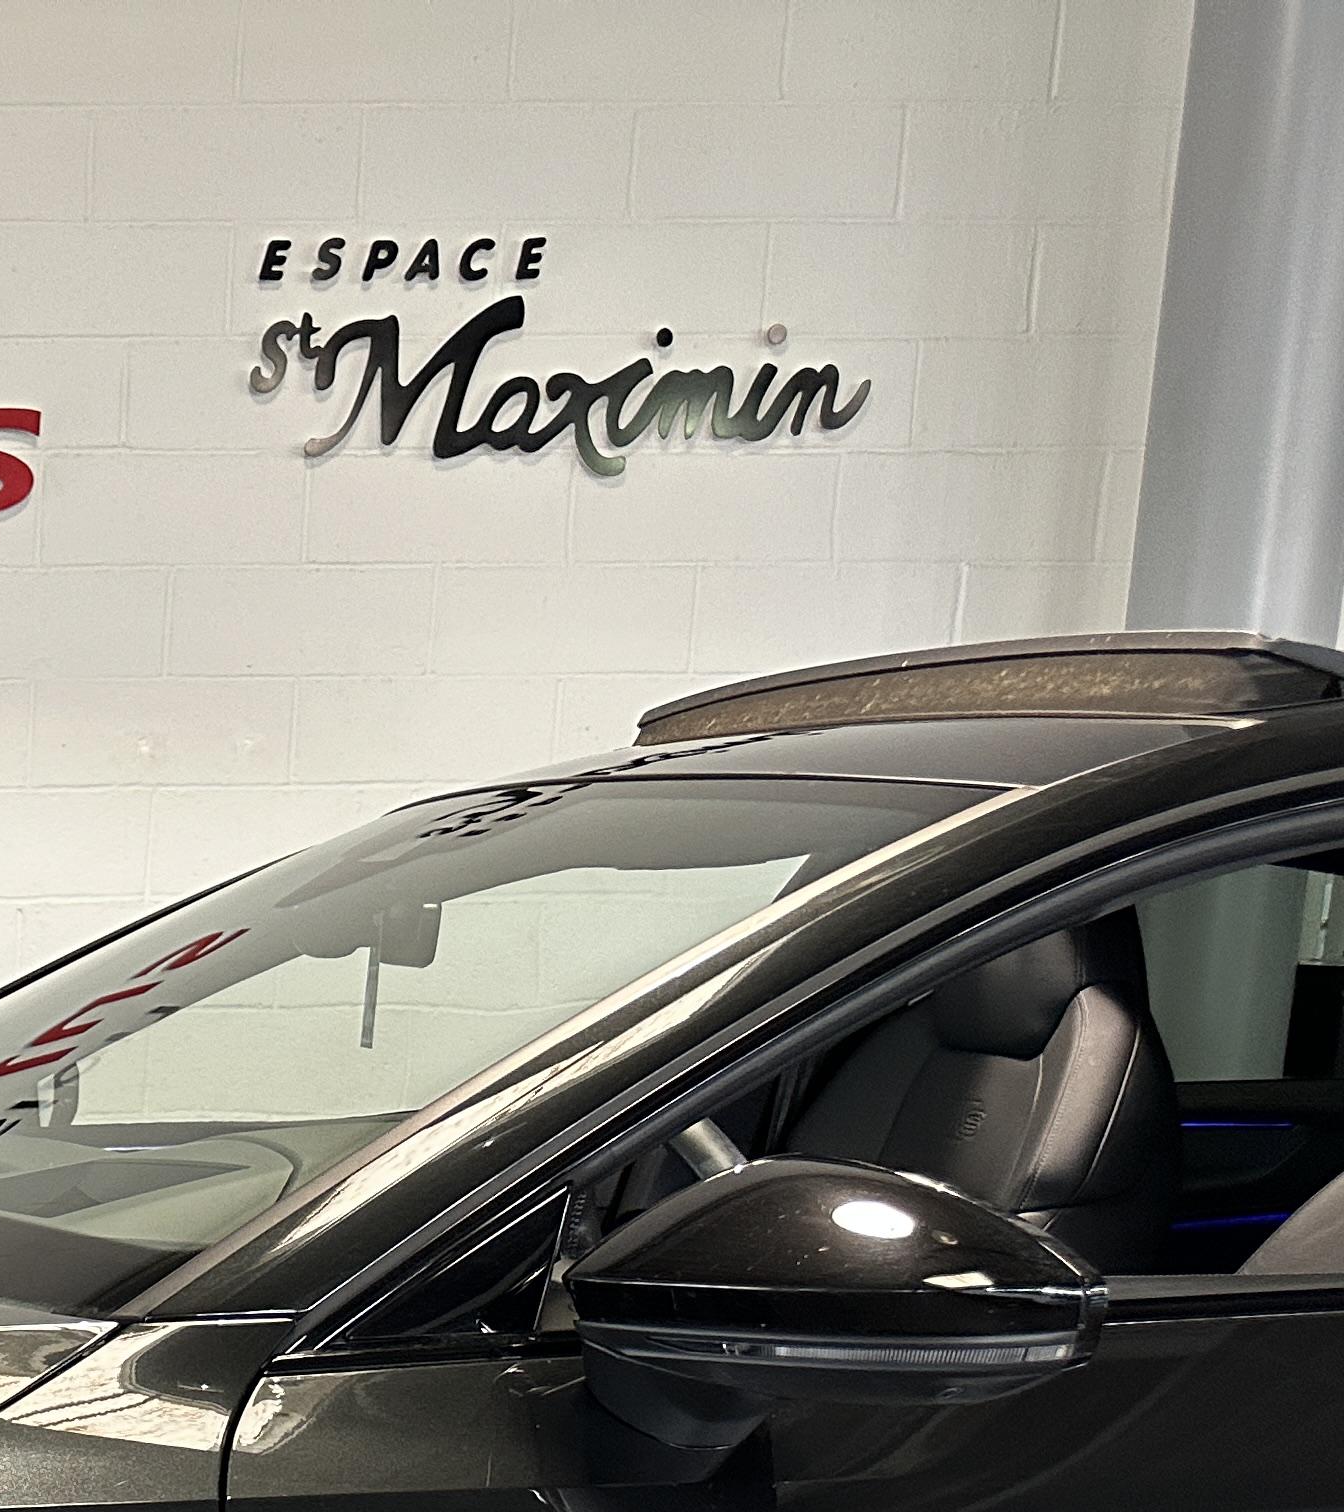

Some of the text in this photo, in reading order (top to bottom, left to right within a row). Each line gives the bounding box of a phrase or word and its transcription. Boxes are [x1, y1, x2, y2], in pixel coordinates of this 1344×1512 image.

[258, 237, 547, 282] ESPACE
[249, 295, 872, 477] St Maximin
